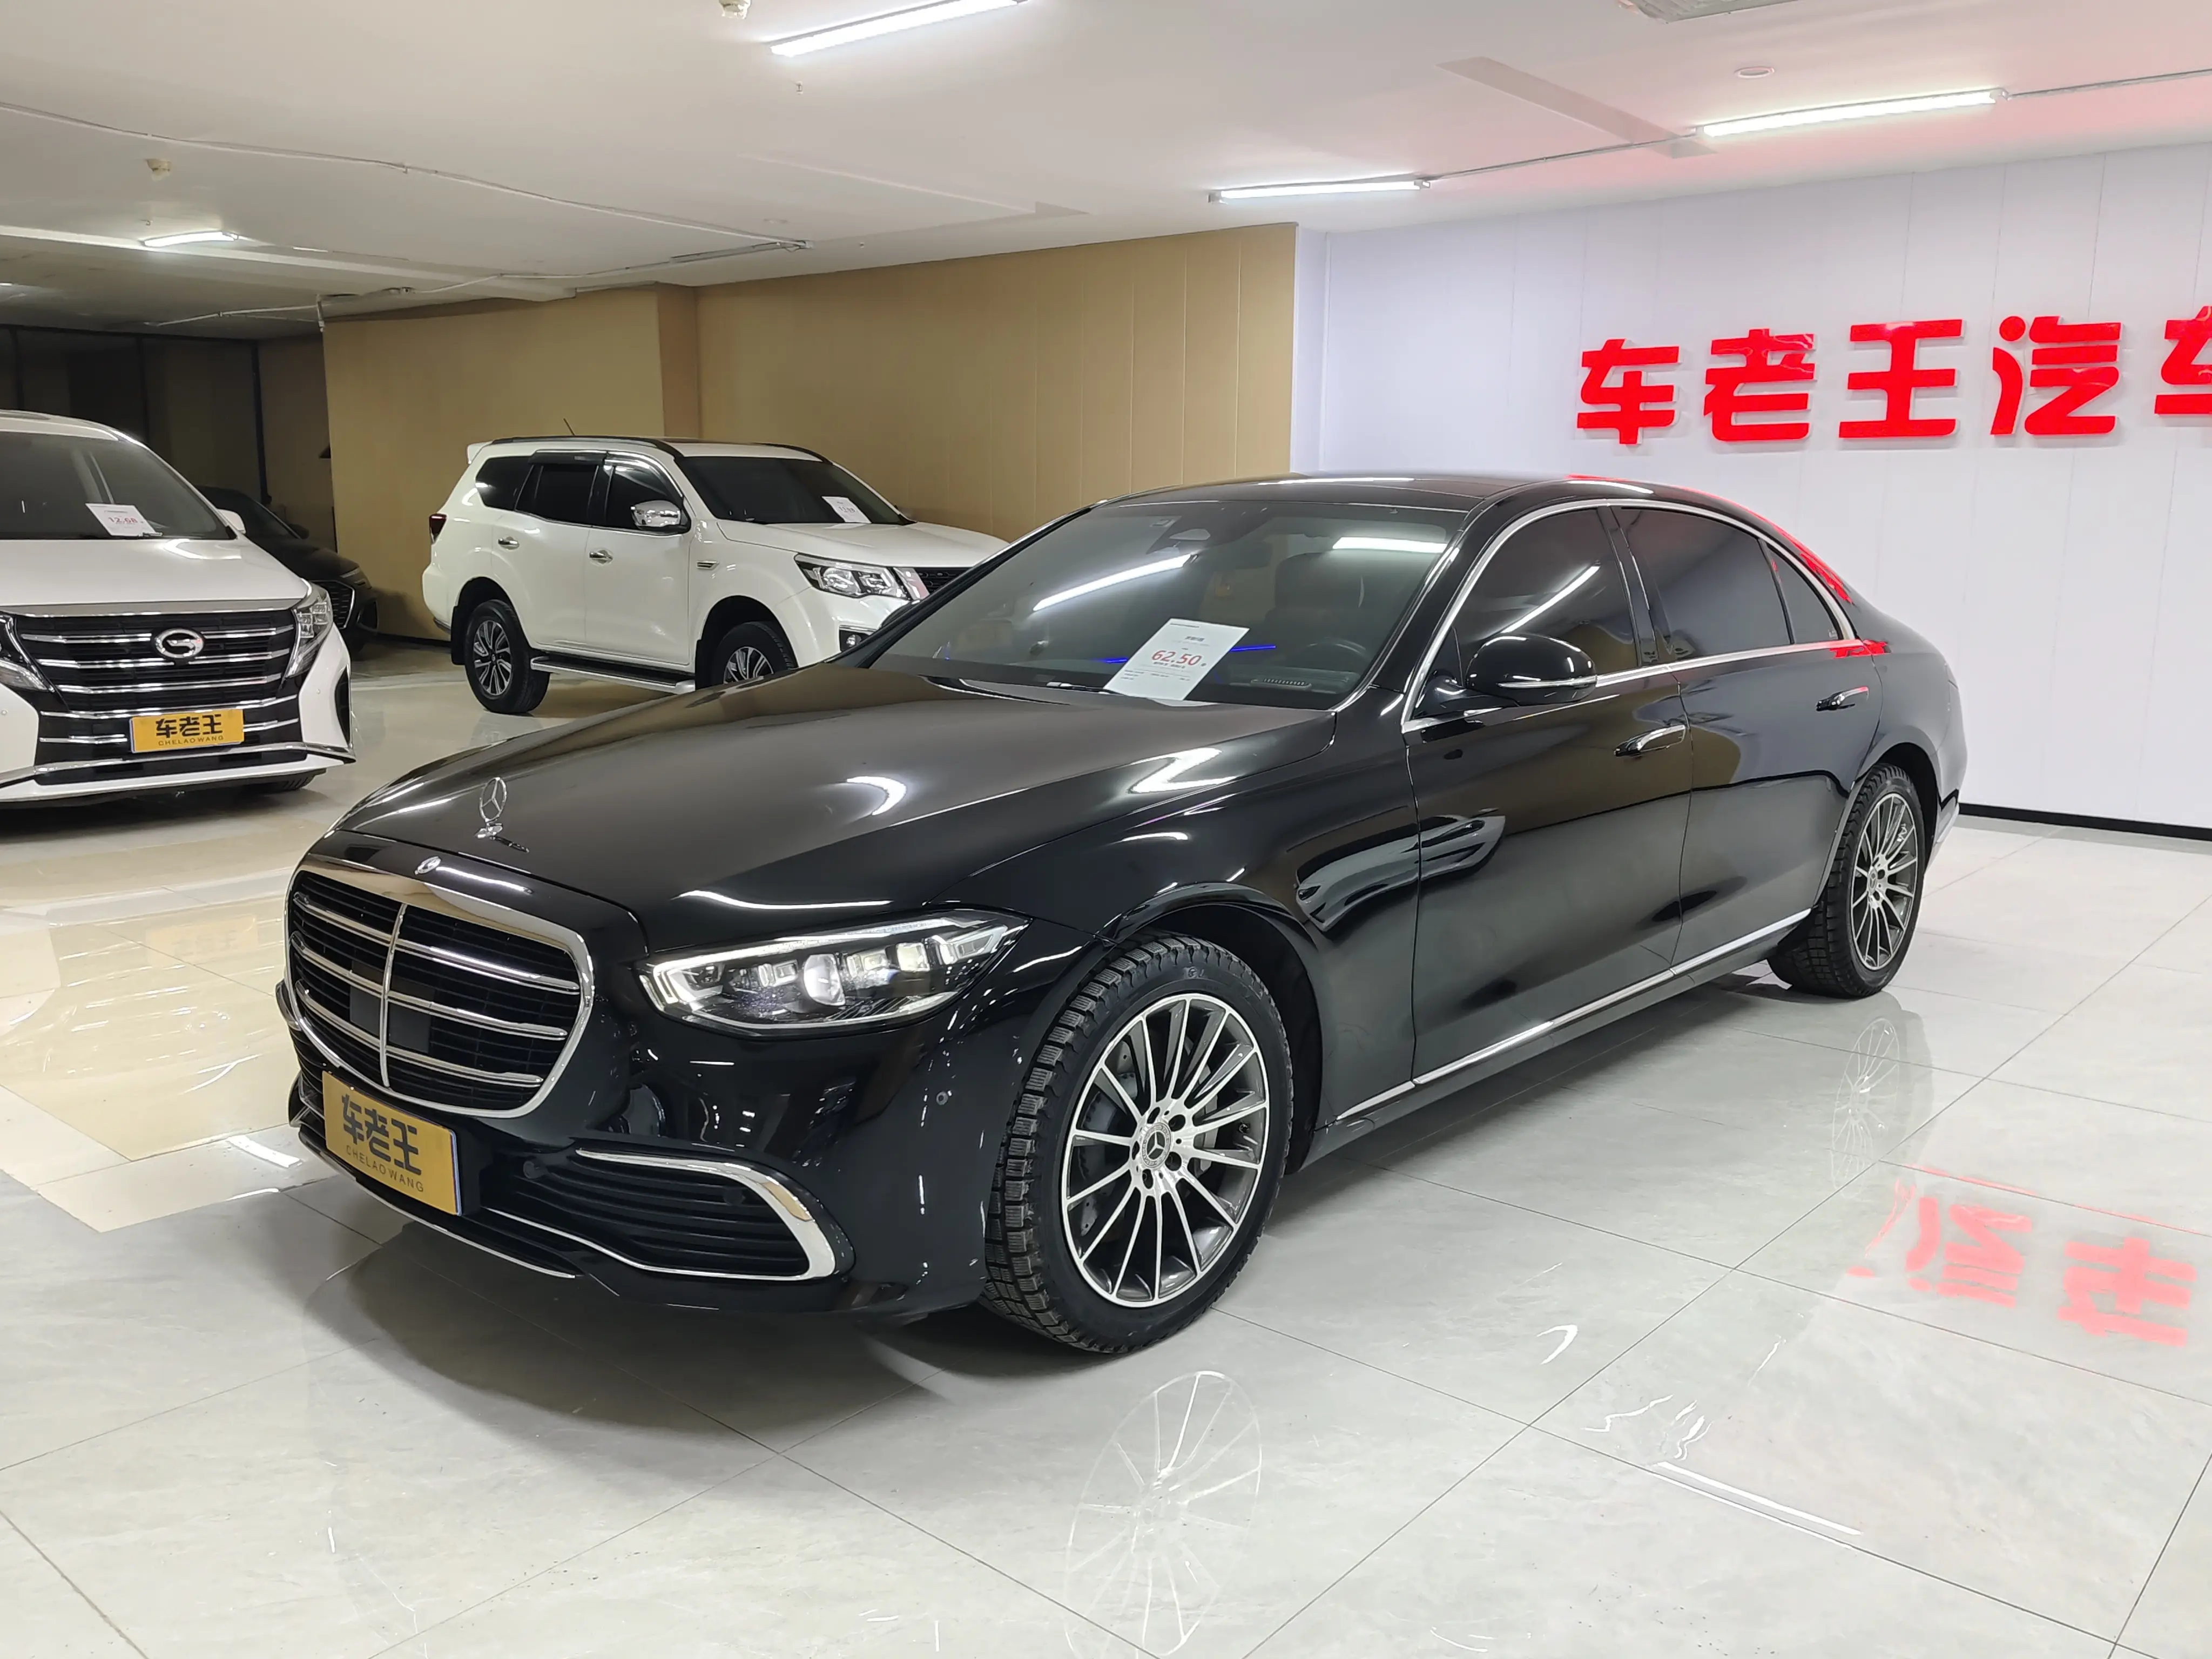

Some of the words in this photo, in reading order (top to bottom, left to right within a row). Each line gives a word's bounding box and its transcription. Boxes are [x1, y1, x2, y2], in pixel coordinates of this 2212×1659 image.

[1151, 650, 1202, 666] 62.50
[155, 713, 223, 739] 车老王
[341, 1094, 422, 1176] 车老王
